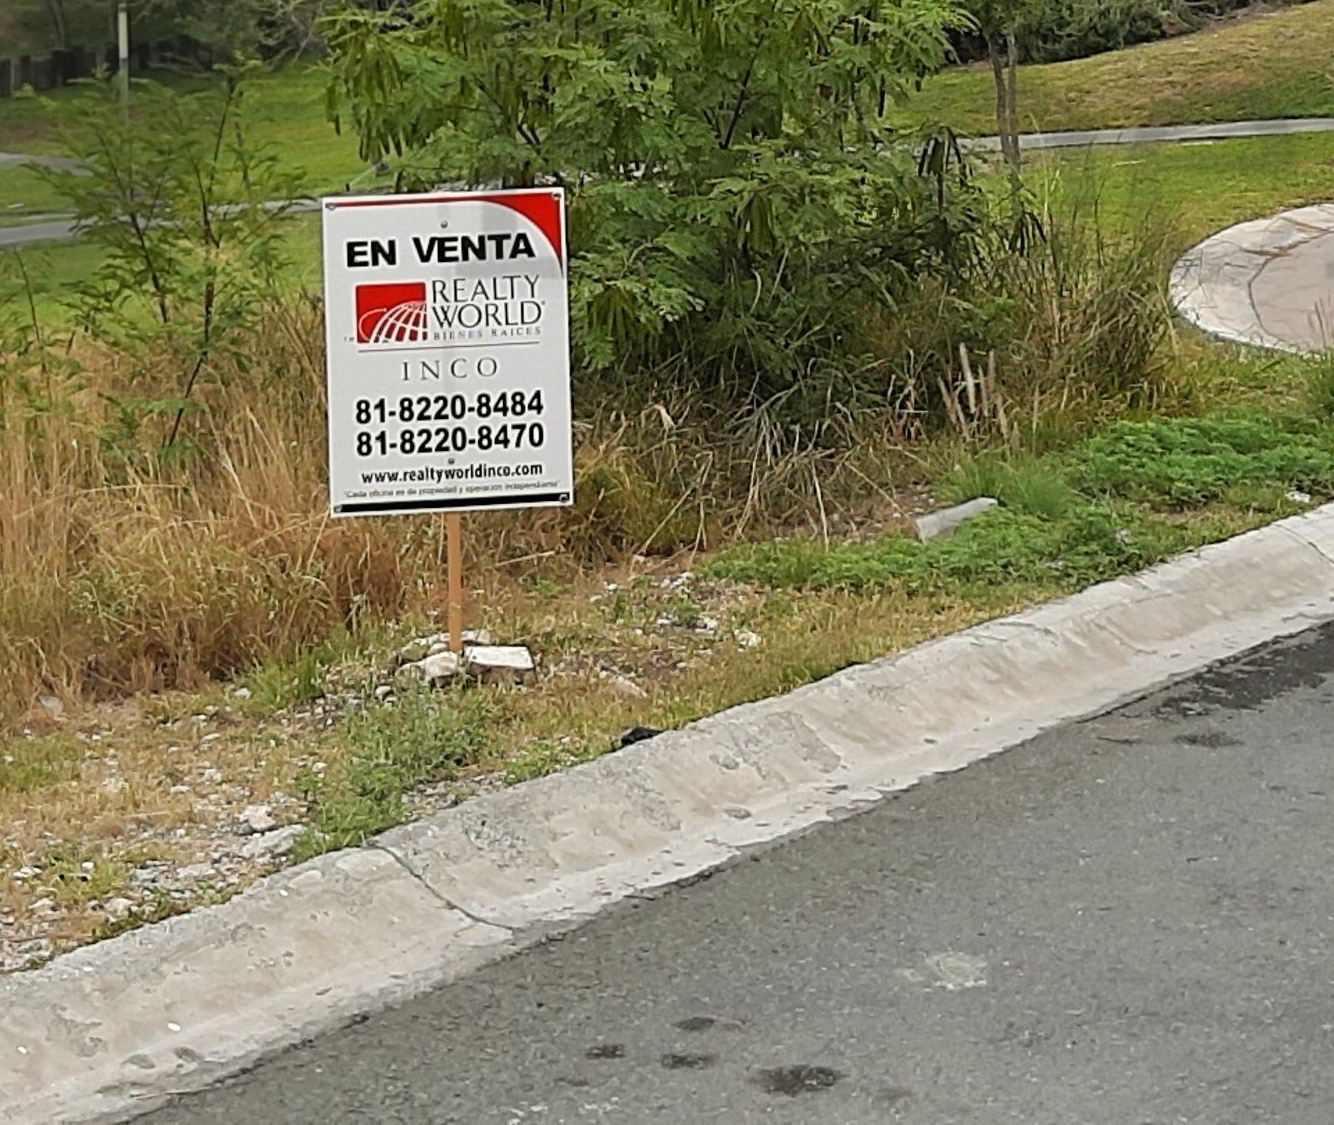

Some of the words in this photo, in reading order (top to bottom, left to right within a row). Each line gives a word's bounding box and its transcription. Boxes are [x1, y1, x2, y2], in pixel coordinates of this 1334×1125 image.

[346, 239, 397, 267] EN
[412, 233, 536, 263] VENTA
[432, 275, 540, 303] REALTY
[432, 301, 543, 329] WORLD
[433, 329, 483, 341] BIENES
[402, 357, 498, 381] INCO
[355, 389, 544, 424] 81-8220-8484
[356, 422, 545, 457] 81-8220-8470
[361, 462, 543, 484] www.realtyworldinco.com
